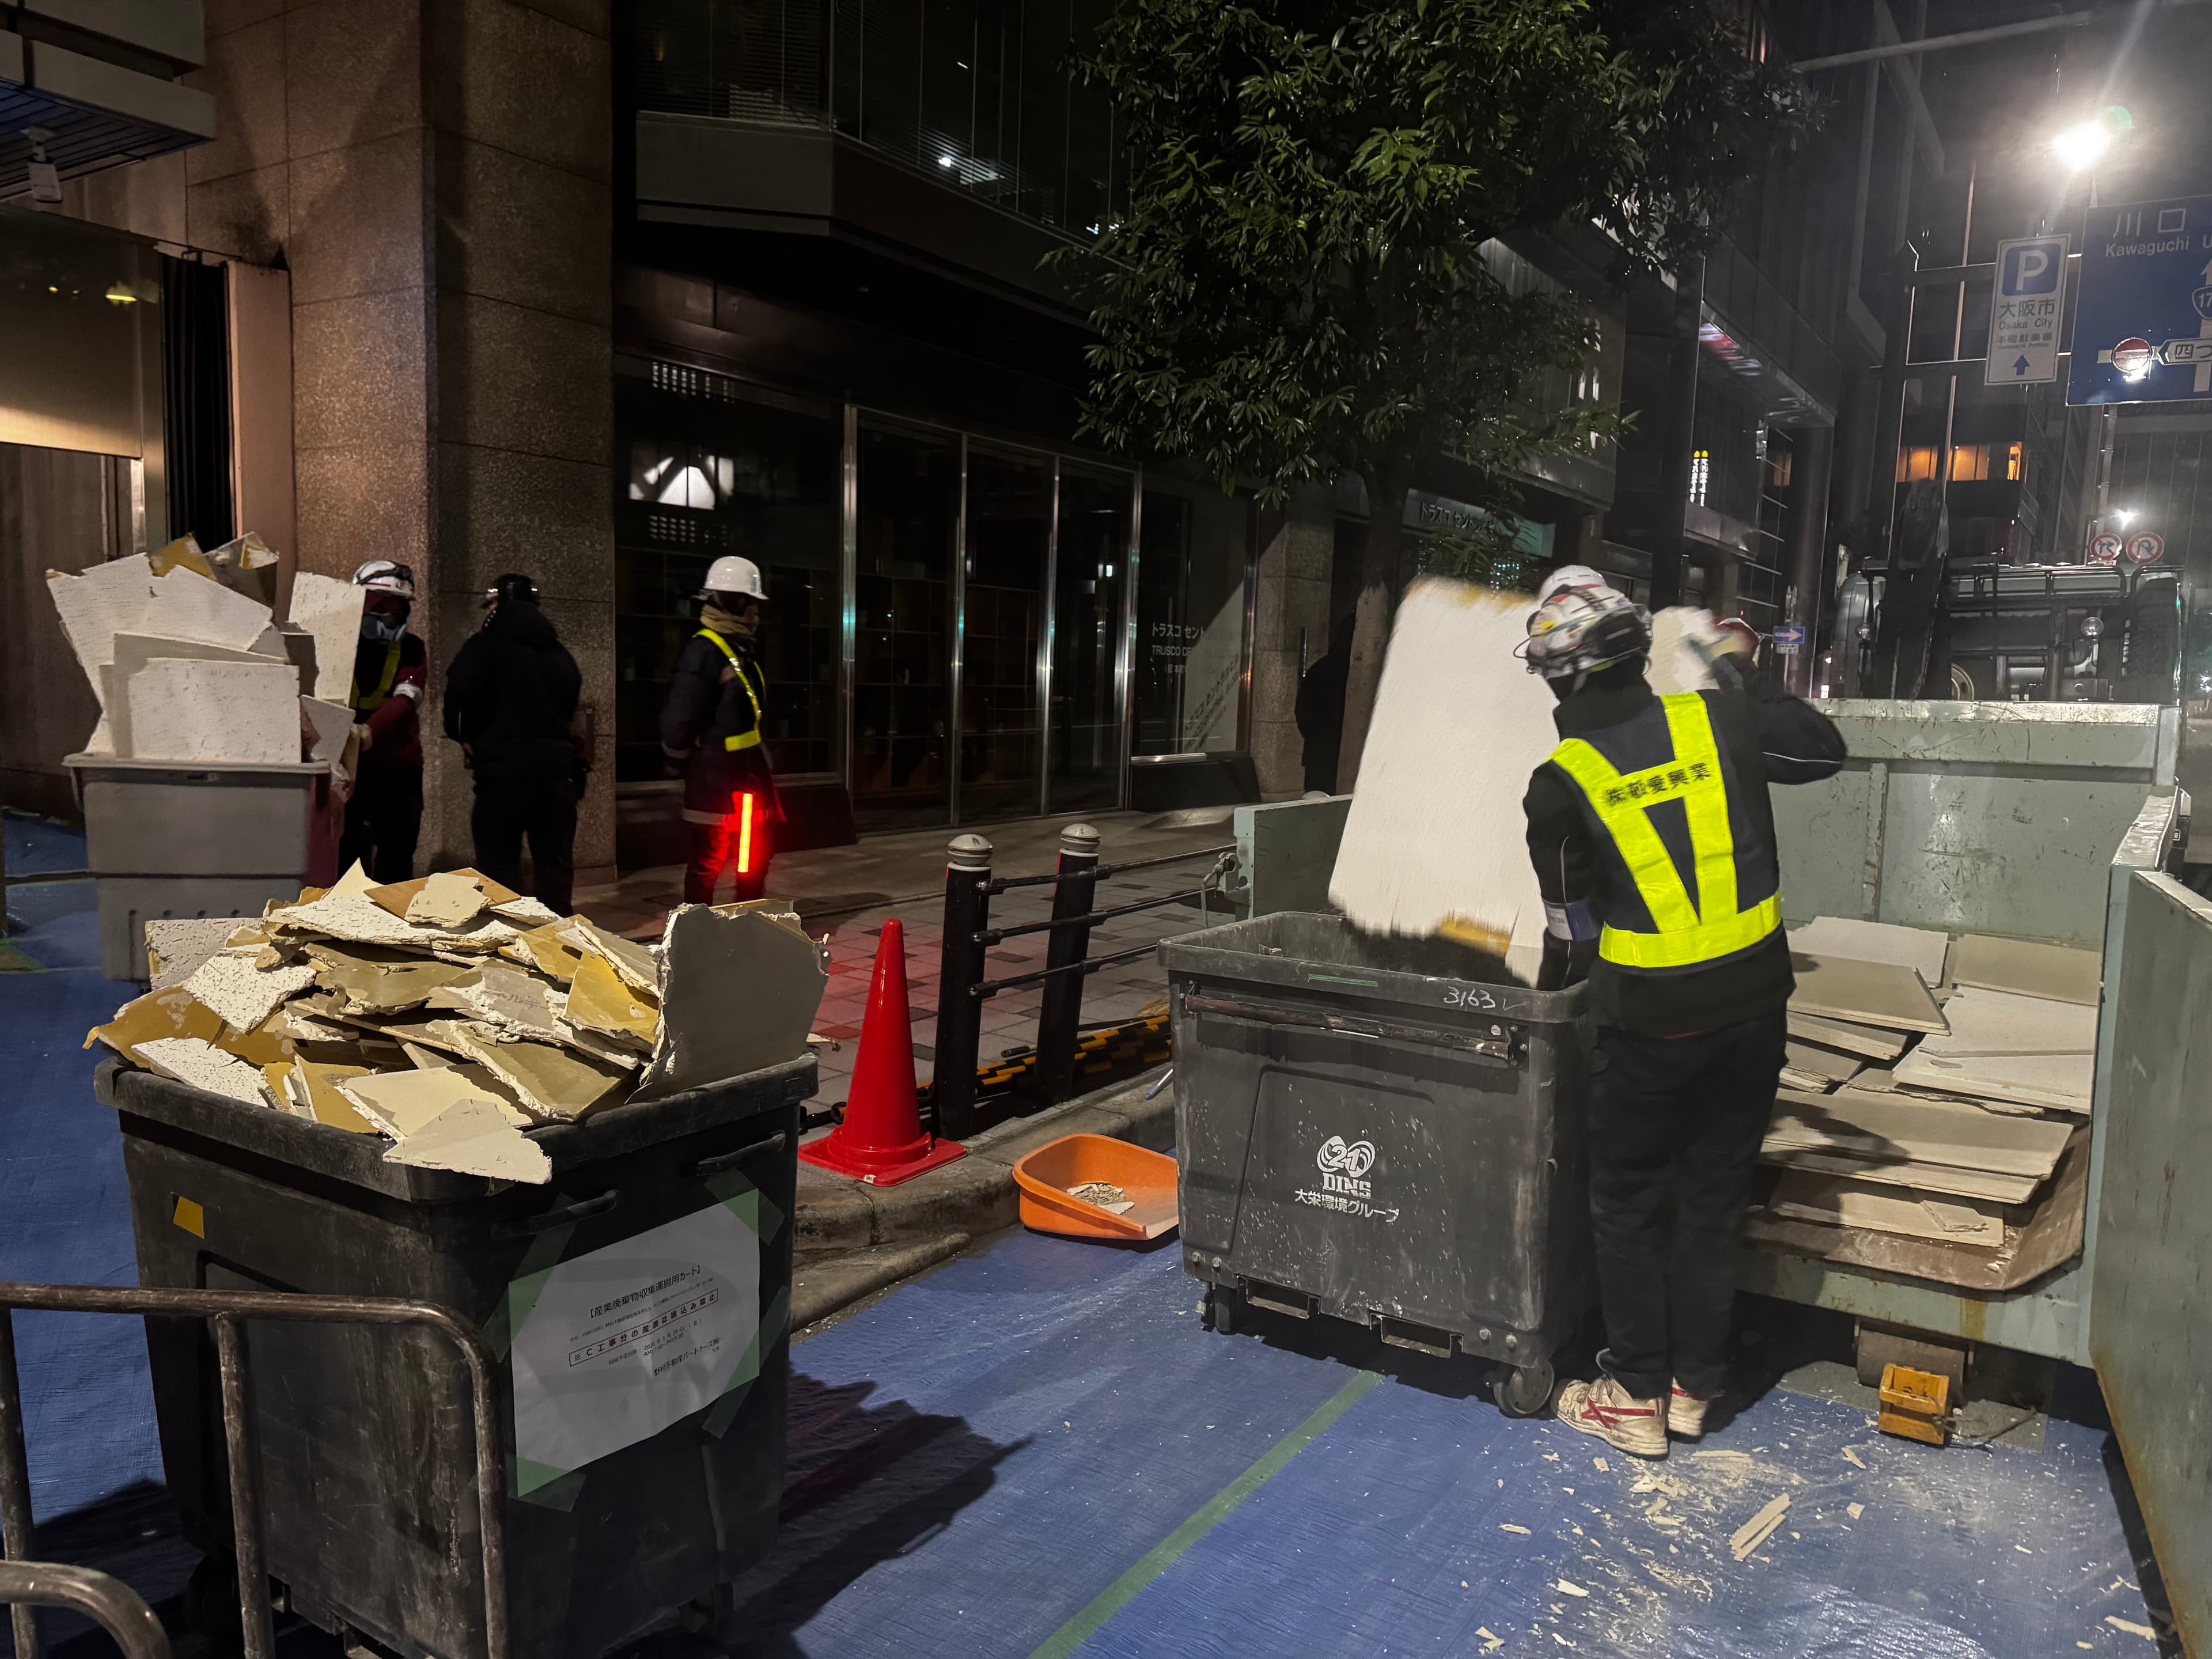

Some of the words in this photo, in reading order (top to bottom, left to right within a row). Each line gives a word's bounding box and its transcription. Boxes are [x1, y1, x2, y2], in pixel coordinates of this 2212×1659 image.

[2113, 208, 2186, 238] 川口
[2106, 236, 2188, 257] Kawaguchi
[2016, 249, 2048, 291] P
[1999, 298, 2056, 318] 大阪市
[1999, 320, 2028, 331] Osaka
[2035, 318, 2054, 329] City
[1152, 622, 1181, 638] トラスコ
[1152, 645, 1180, 656] TRUSCO
[1444, 986, 1495, 1009] 3163
[1323, 1172, 1371, 1199] DINS
[1294, 1187, 1400, 1222] 大栄環境グループ
